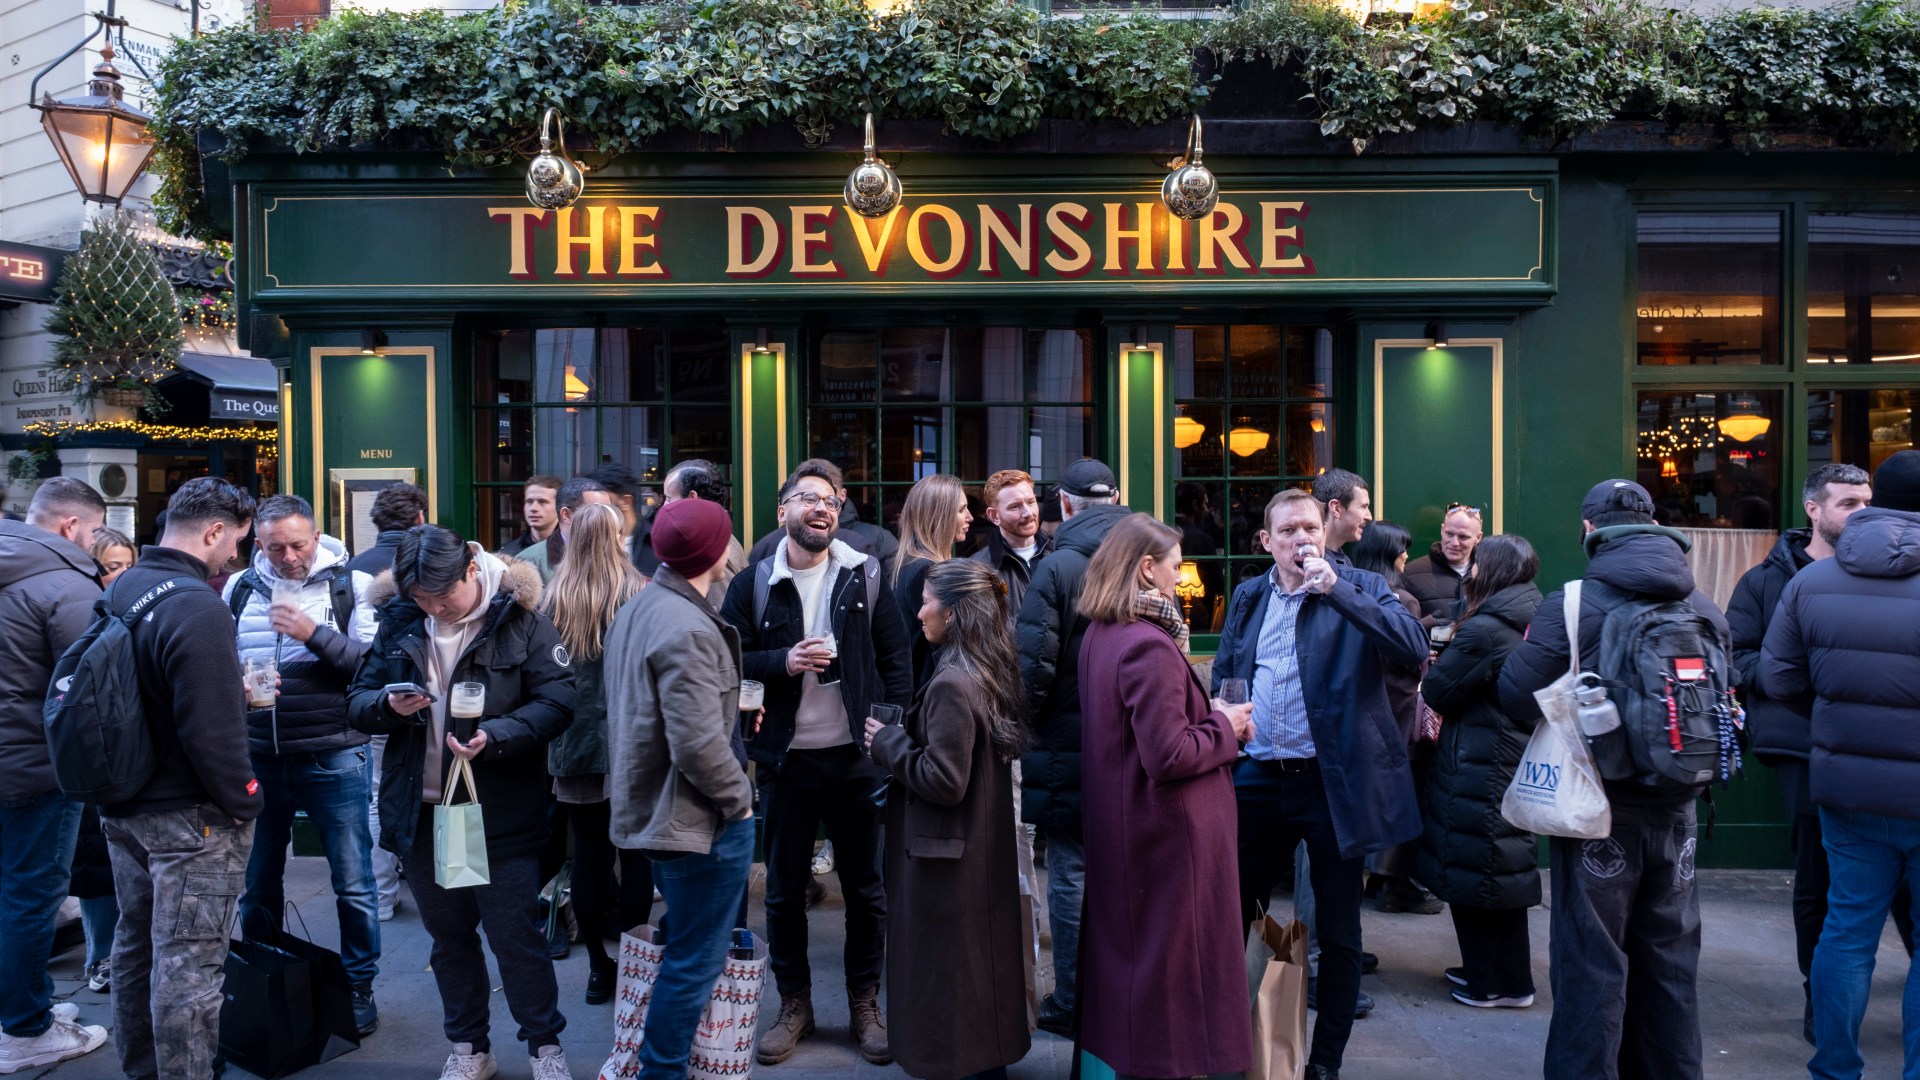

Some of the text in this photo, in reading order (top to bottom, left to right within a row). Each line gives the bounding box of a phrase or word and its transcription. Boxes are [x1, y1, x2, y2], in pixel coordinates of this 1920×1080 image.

[487, 201, 1317, 279] THE DEVONSHIRE
[223, 399, 279, 416] The Que
[360, 449, 393, 459] MENU
[132, 581, 176, 613] NIKE AIR
